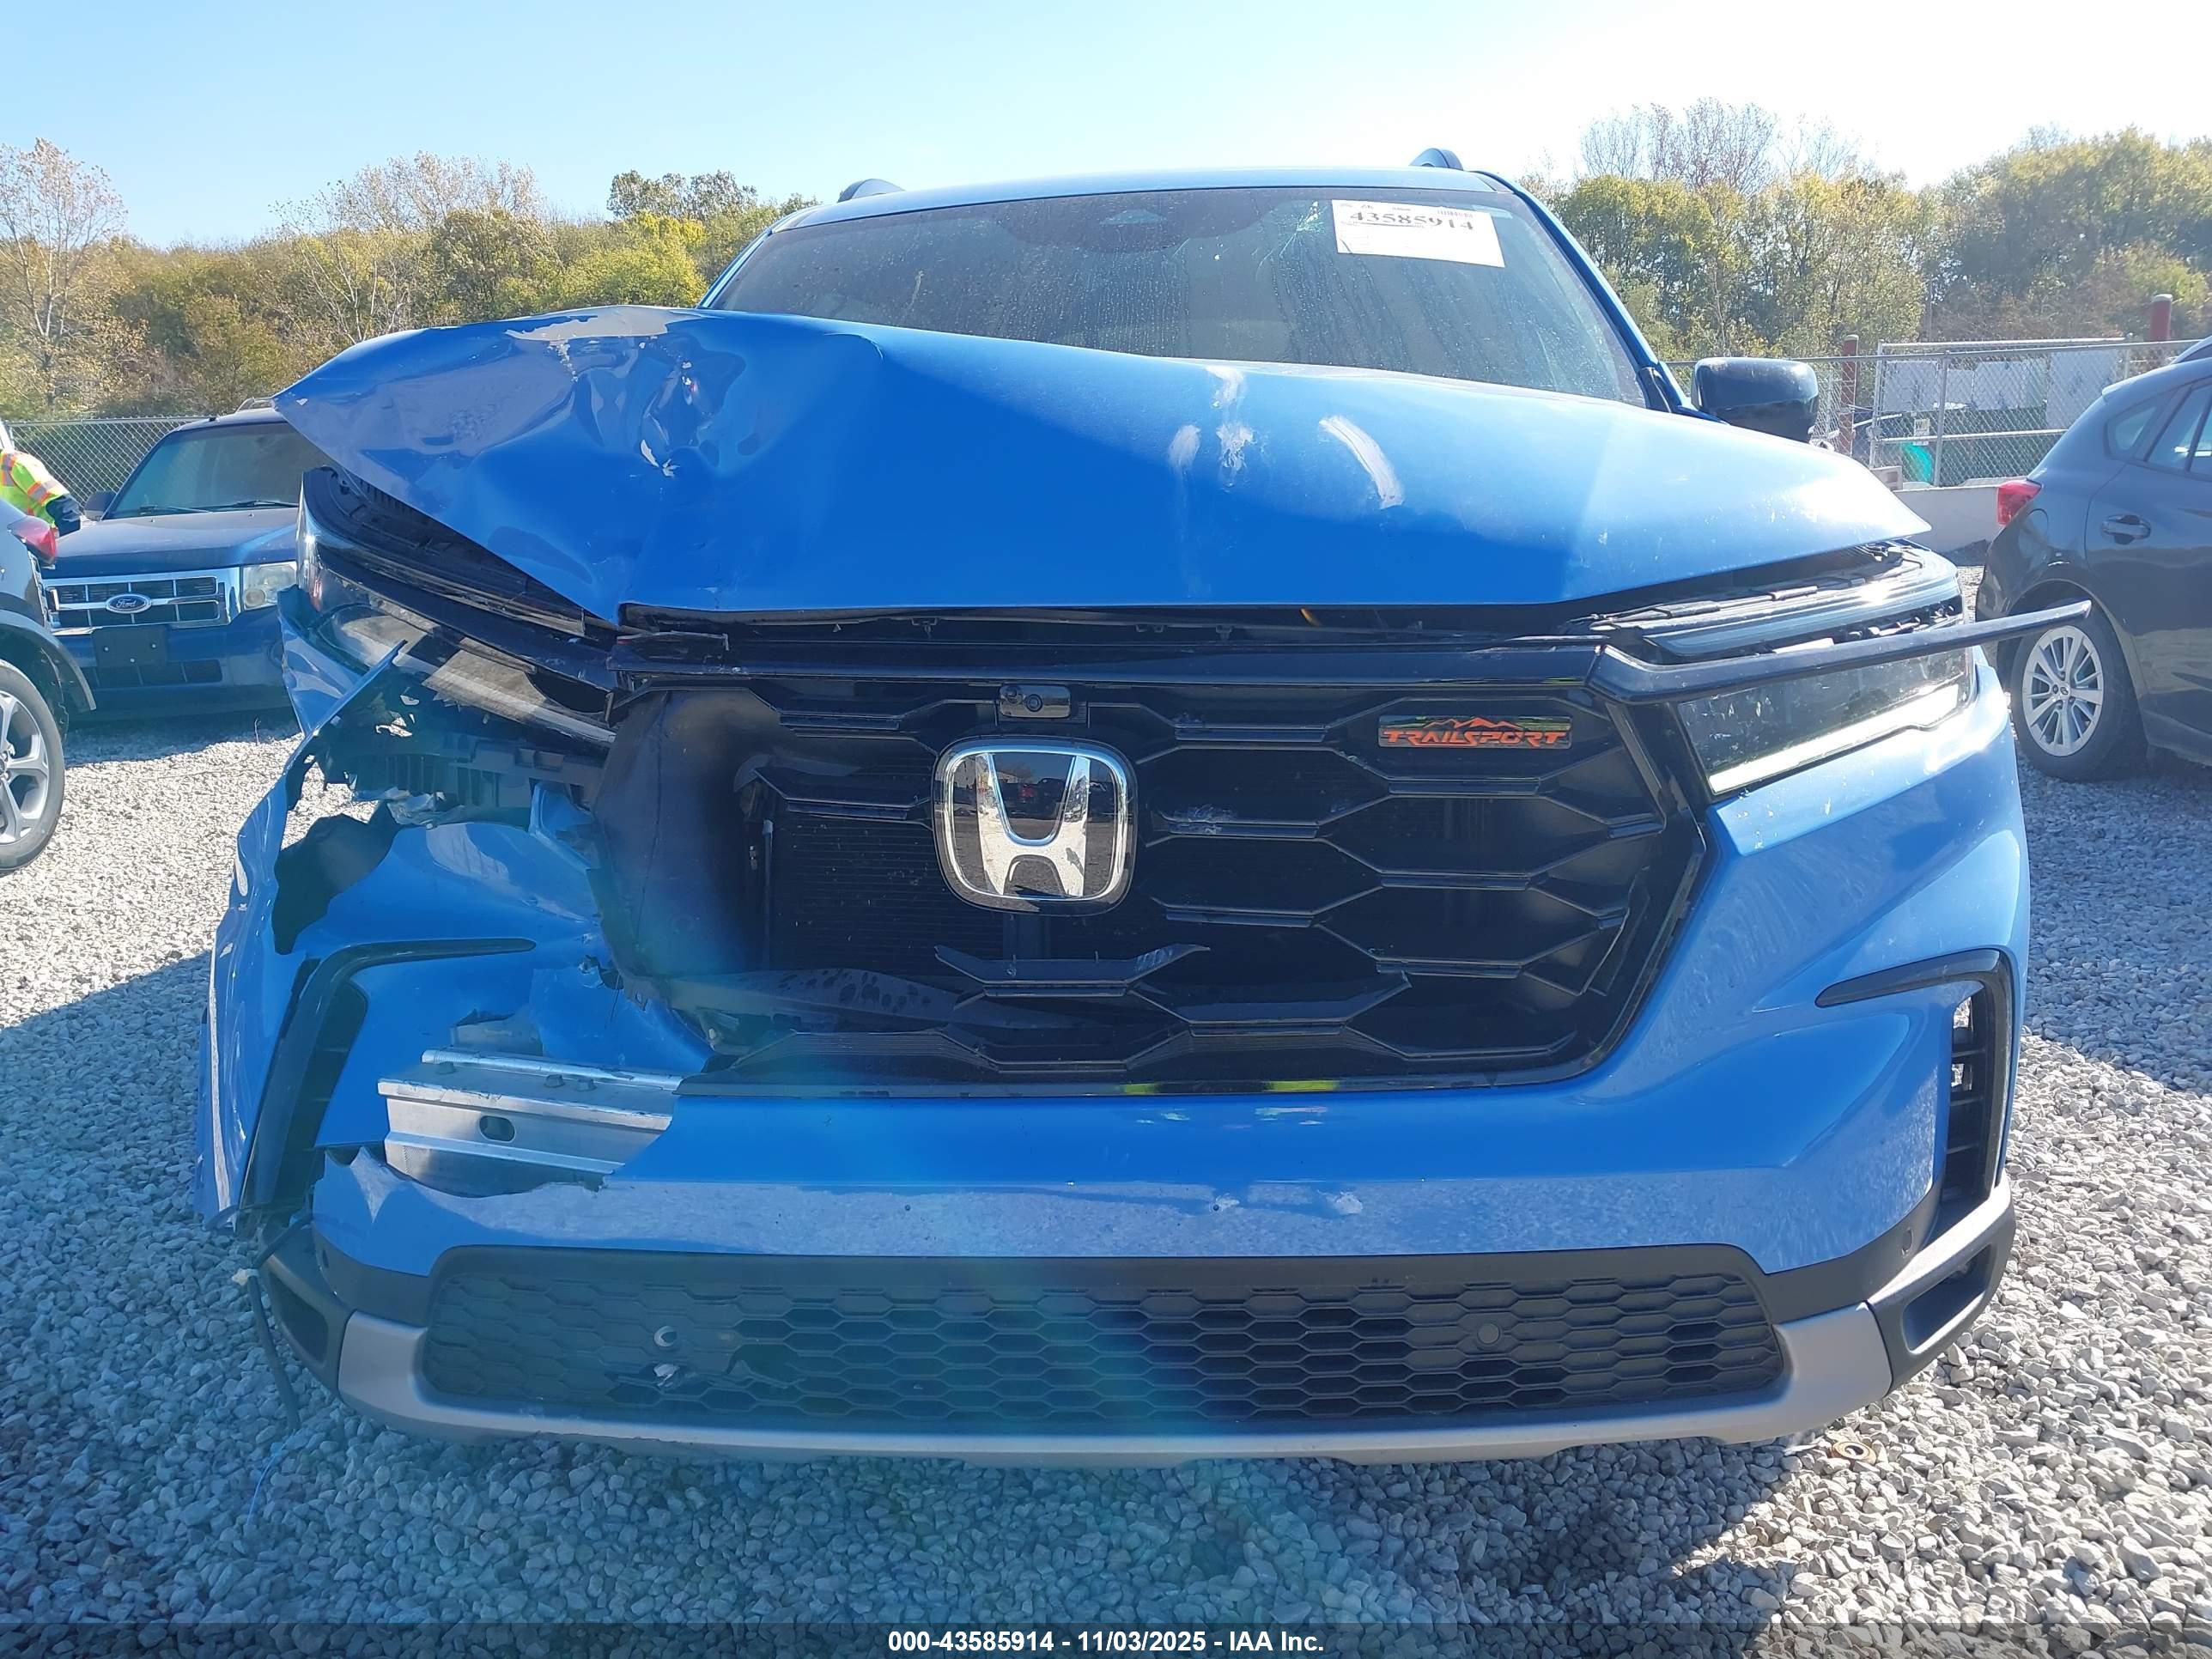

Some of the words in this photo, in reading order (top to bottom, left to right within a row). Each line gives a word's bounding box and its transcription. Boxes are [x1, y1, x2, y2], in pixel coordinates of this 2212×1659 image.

[1350, 211, 1474, 230] 43585914
[116, 598, 137, 608] Ford
[1383, 731, 1566, 747] TRAILSPORT
